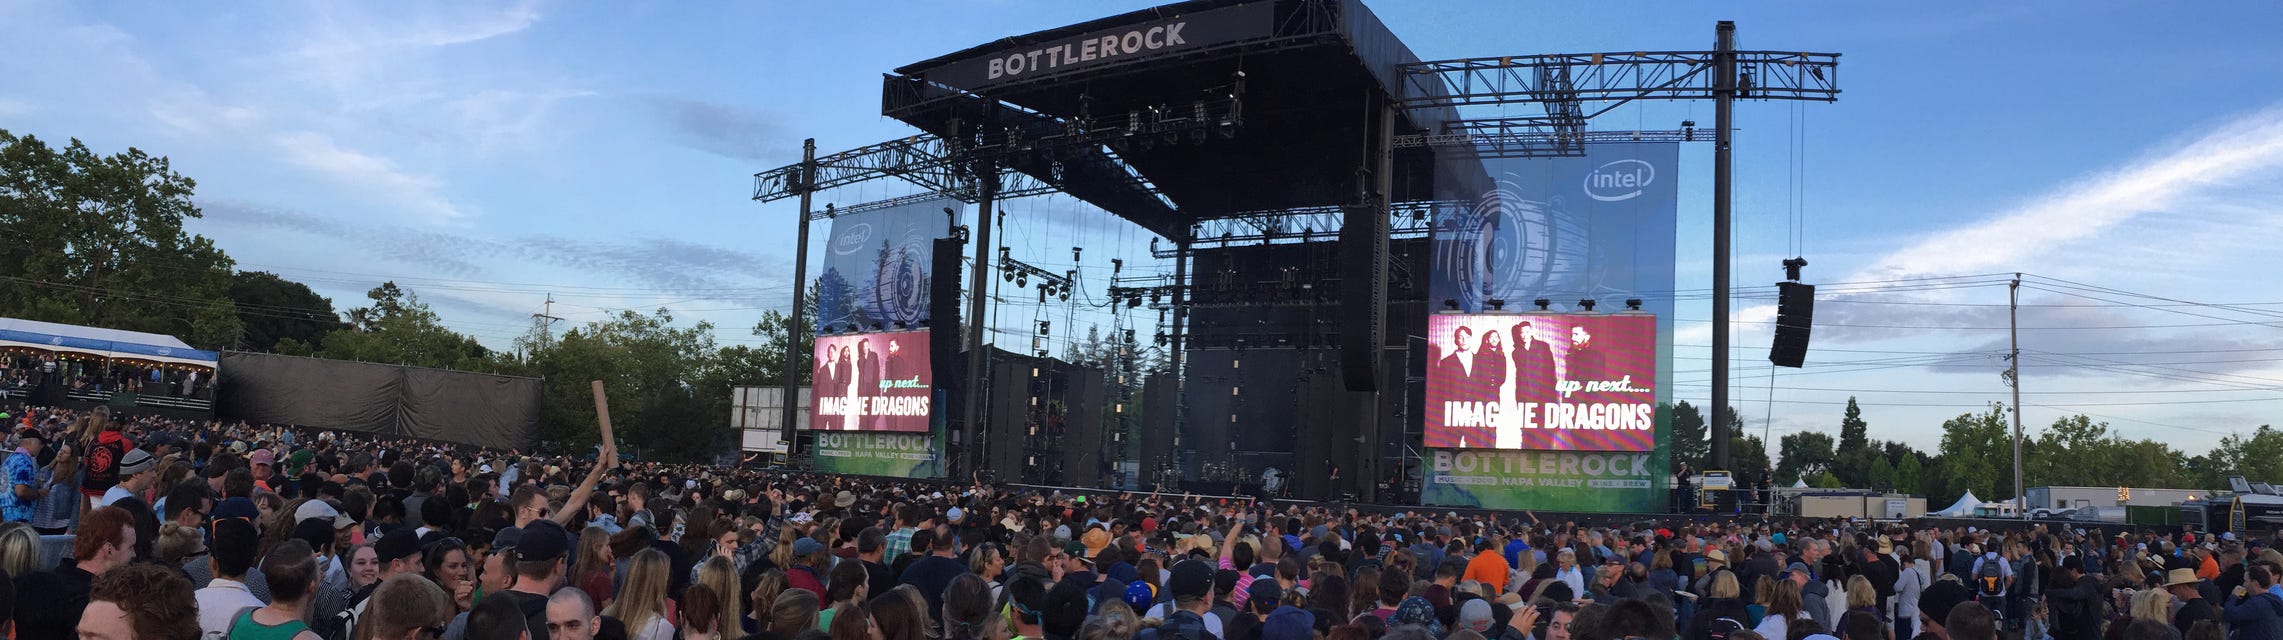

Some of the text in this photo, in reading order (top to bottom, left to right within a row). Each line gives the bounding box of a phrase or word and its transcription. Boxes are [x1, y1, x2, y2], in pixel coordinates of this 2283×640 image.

[988, 22, 1186, 80] BOTTLEROCK
[1593, 168, 1642, 188] intel
[840, 230, 866, 246] intel
[879, 379, 893, 393] up
[1555, 380, 1583, 398] up
[819, 395, 929, 416] IMAGNE DRAGONS
[1444, 401, 1651, 430] IMAGNE DRAGONS
[819, 433, 936, 451] BOTTLEROCK
[875, 451, 899, 459] VALLEY
[1434, 451, 1651, 476] BOTTLEROCK
[1502, 475, 1534, 486] NAPA
[1538, 478, 1583, 488] VALLEY
